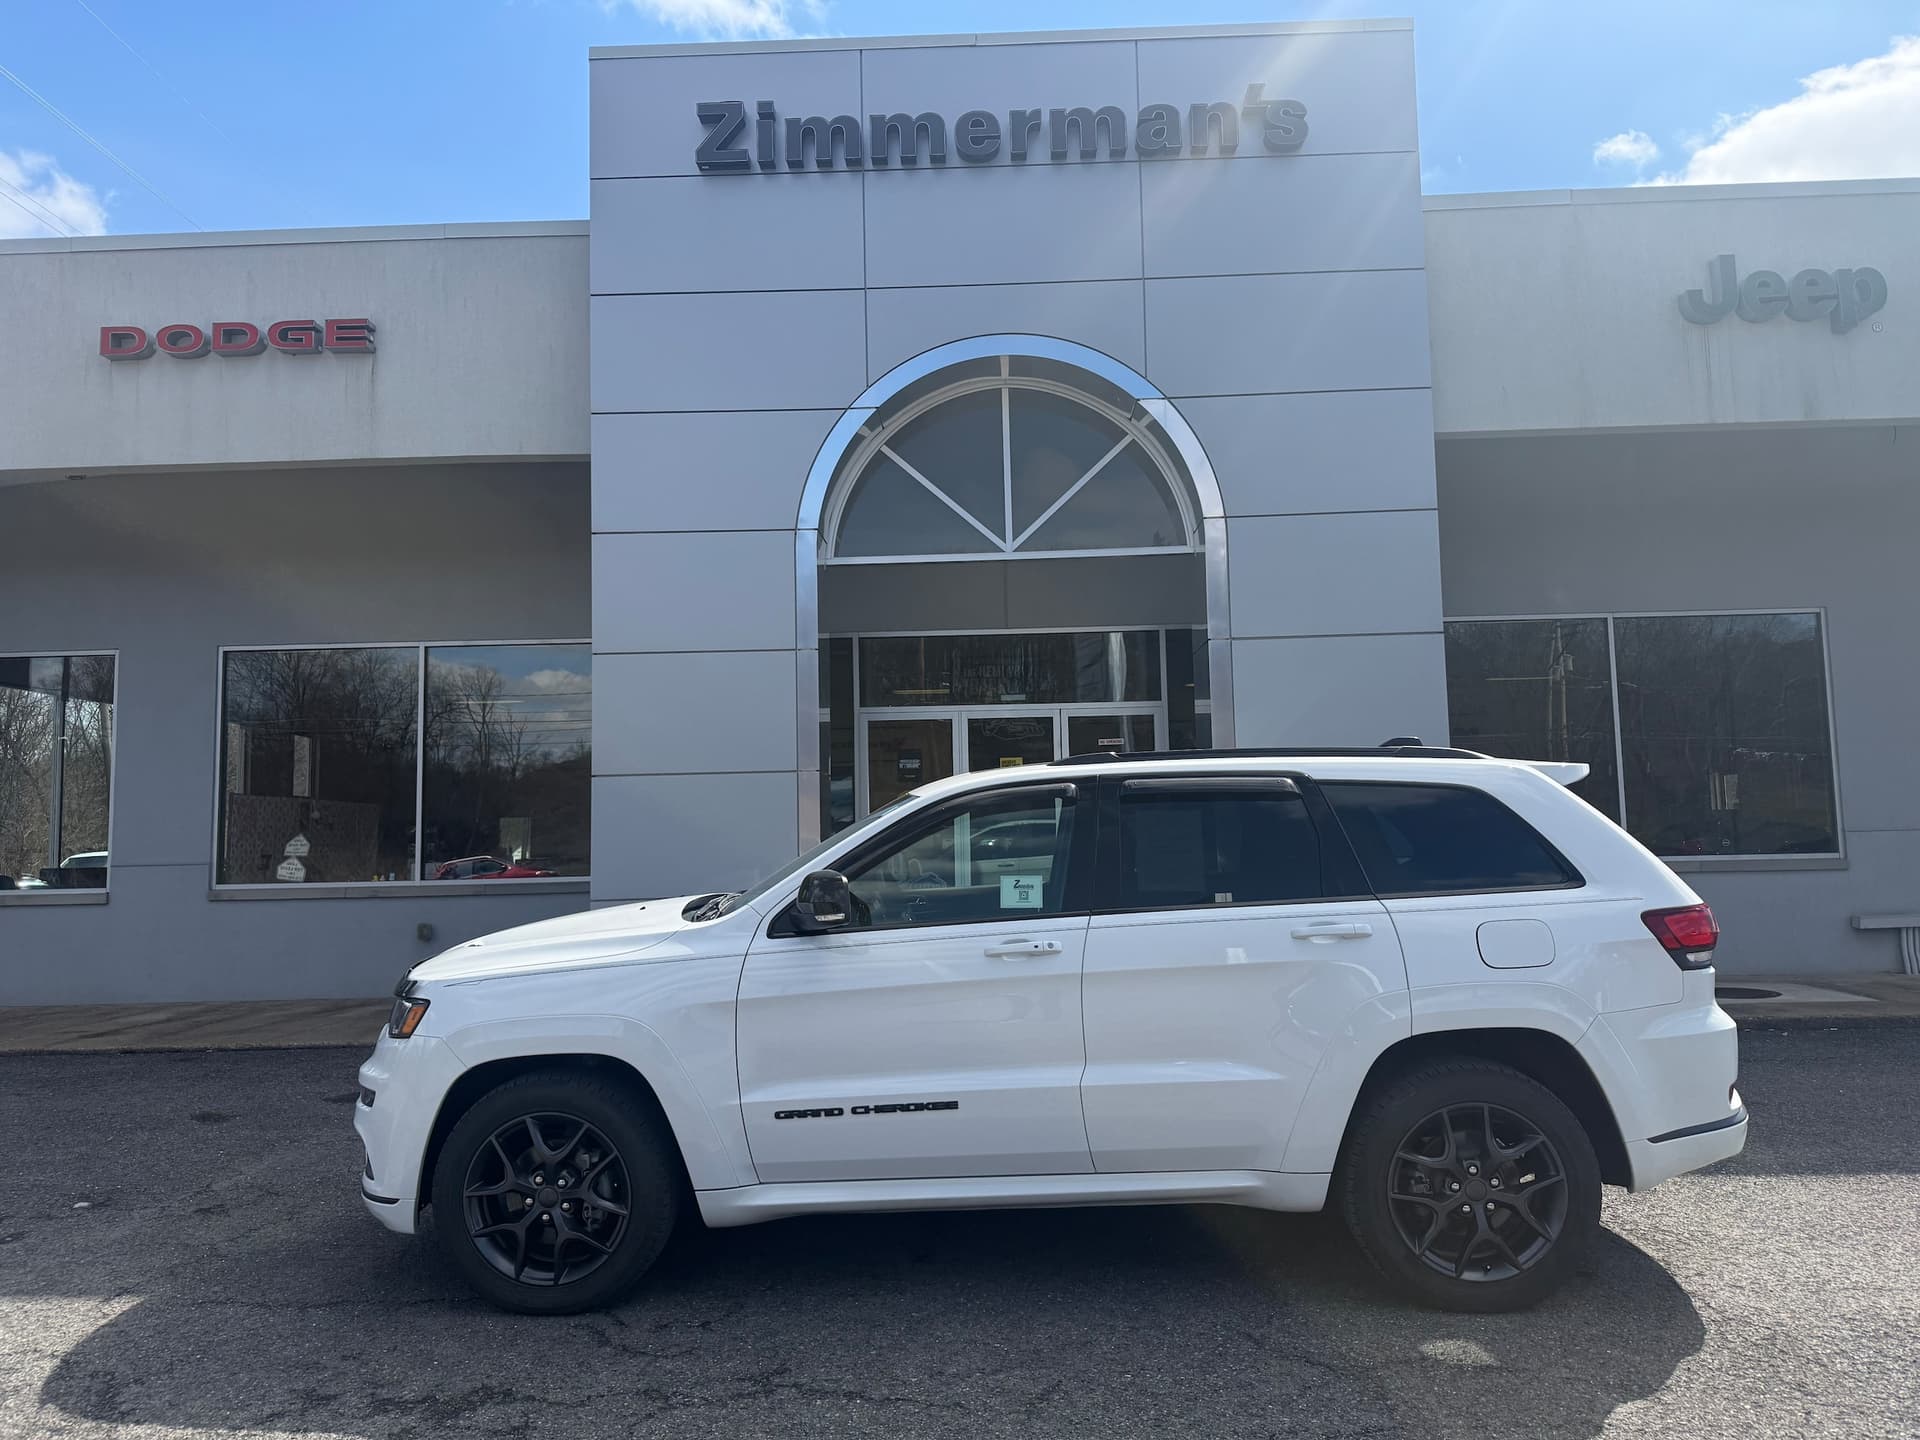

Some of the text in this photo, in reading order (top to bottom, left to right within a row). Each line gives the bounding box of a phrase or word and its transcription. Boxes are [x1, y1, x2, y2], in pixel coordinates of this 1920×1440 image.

[695, 83, 1309, 171] Zimmerman's
[1678, 254, 1888, 335] Jeep
[100, 318, 376, 361] DODGE
[774, 1100, 959, 1119] GRAND CHEROKEE
